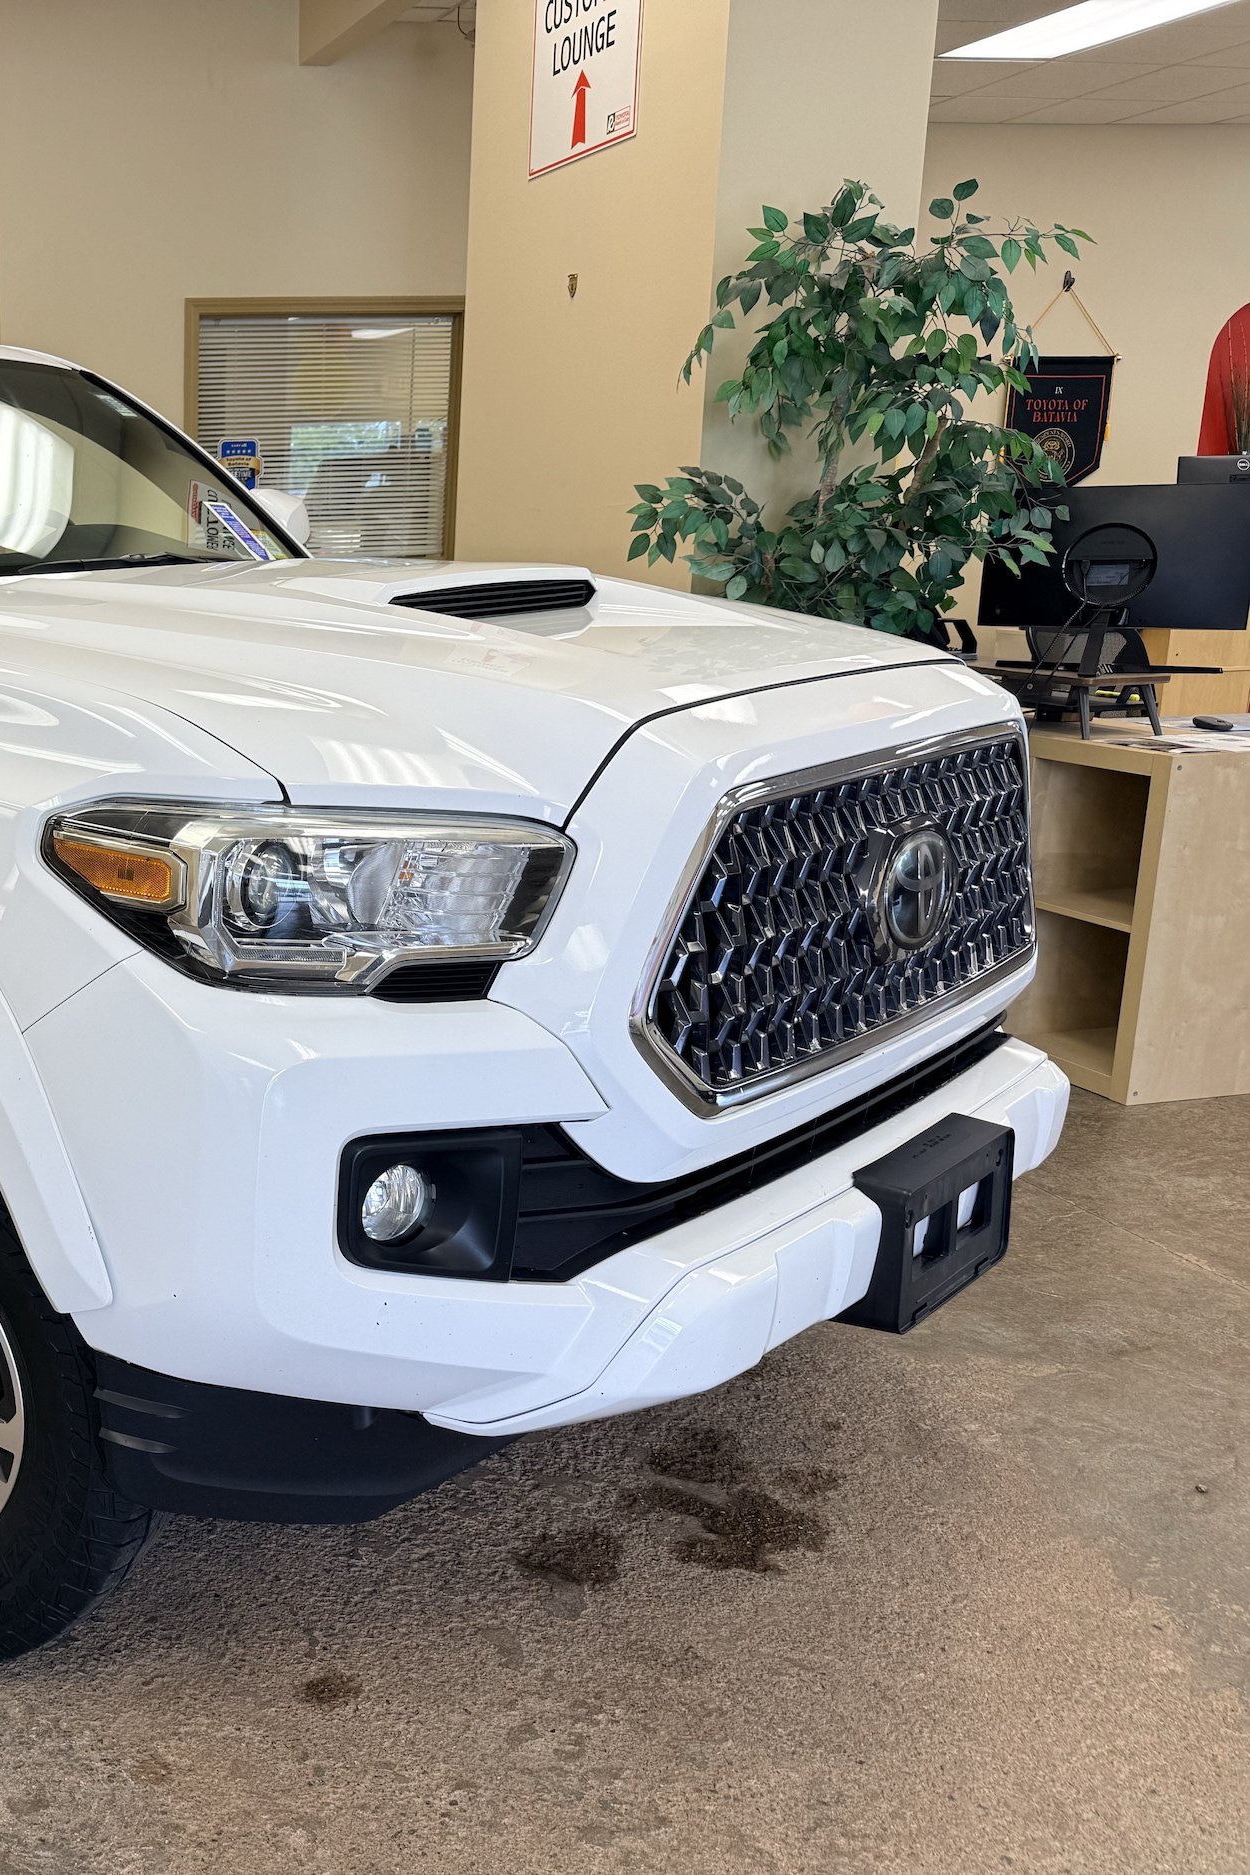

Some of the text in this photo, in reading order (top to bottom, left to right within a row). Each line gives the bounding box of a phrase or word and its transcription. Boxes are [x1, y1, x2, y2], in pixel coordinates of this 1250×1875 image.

[552, 9, 617, 76] LOUNGE
[1054, 386, 1064, 395] IX
[1025, 399, 1089, 411] TOYOTA OF
[1032, 411, 1079, 423] BATAVIA
